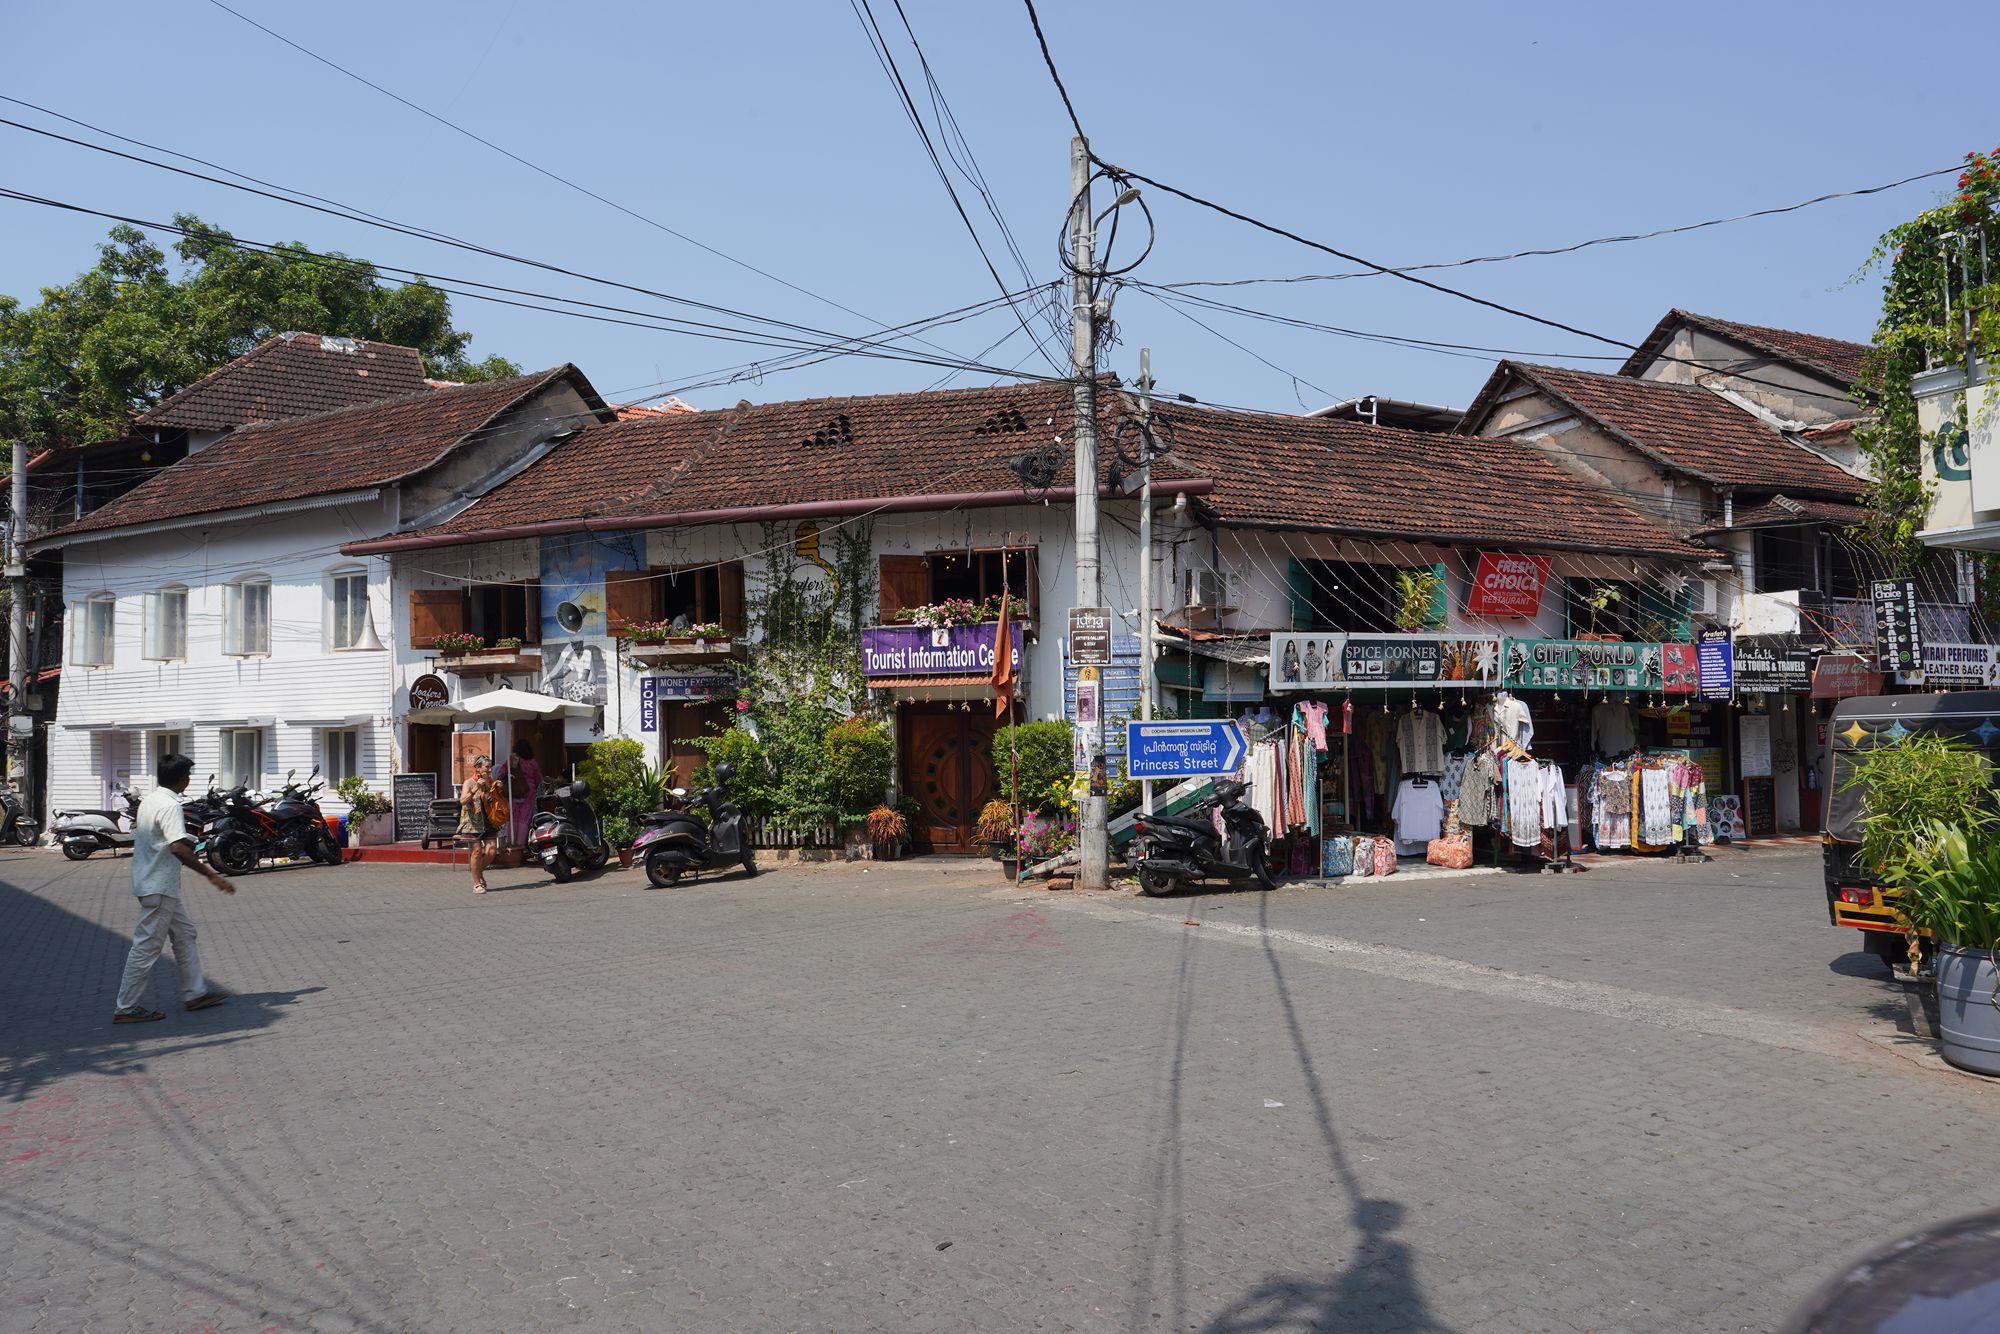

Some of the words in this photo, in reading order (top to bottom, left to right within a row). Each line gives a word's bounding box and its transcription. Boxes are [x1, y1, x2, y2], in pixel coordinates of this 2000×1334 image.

[1497, 560, 1536, 574] FRESH
[1874, 582, 1896, 591] Fresh
[1483, 595, 1531, 605] RESTAURANT
[1875, 590, 1901, 599] Choice
[1906, 582, 1921, 668] RESTAURANT
[1884, 601, 1900, 671] RESTAURANT
[865, 647, 906, 670] Tourist
[909, 645, 976, 669] Information
[978, 643, 1019, 666] Cee
[1346, 646, 1381, 659] SPICE
[1385, 646, 1438, 659] CORNER
[1533, 643, 1572, 665] GIFT
[1737, 648, 1776, 660] Arafath
[1948, 648, 1988, 662] PERFUMES
[1747, 660, 1770, 672] TOURS
[1771, 662, 1777, 671] &
[1777, 661, 1806, 672] TRAVELS
[1820, 663, 1850, 675] FRESH
[1924, 663, 1960, 675] LEATHER
[1962, 664, 1984, 676] BAGS
[660, 678, 689, 687] MONEY
[1830, 680, 1866, 688] RESTAURANT
[412, 685, 442, 700] Loafers
[418, 699, 447, 709] Corner
[643, 680, 654, 729] FOREX
[1133, 759, 1179, 771] Princess
[1184, 757, 1218, 770] Street
